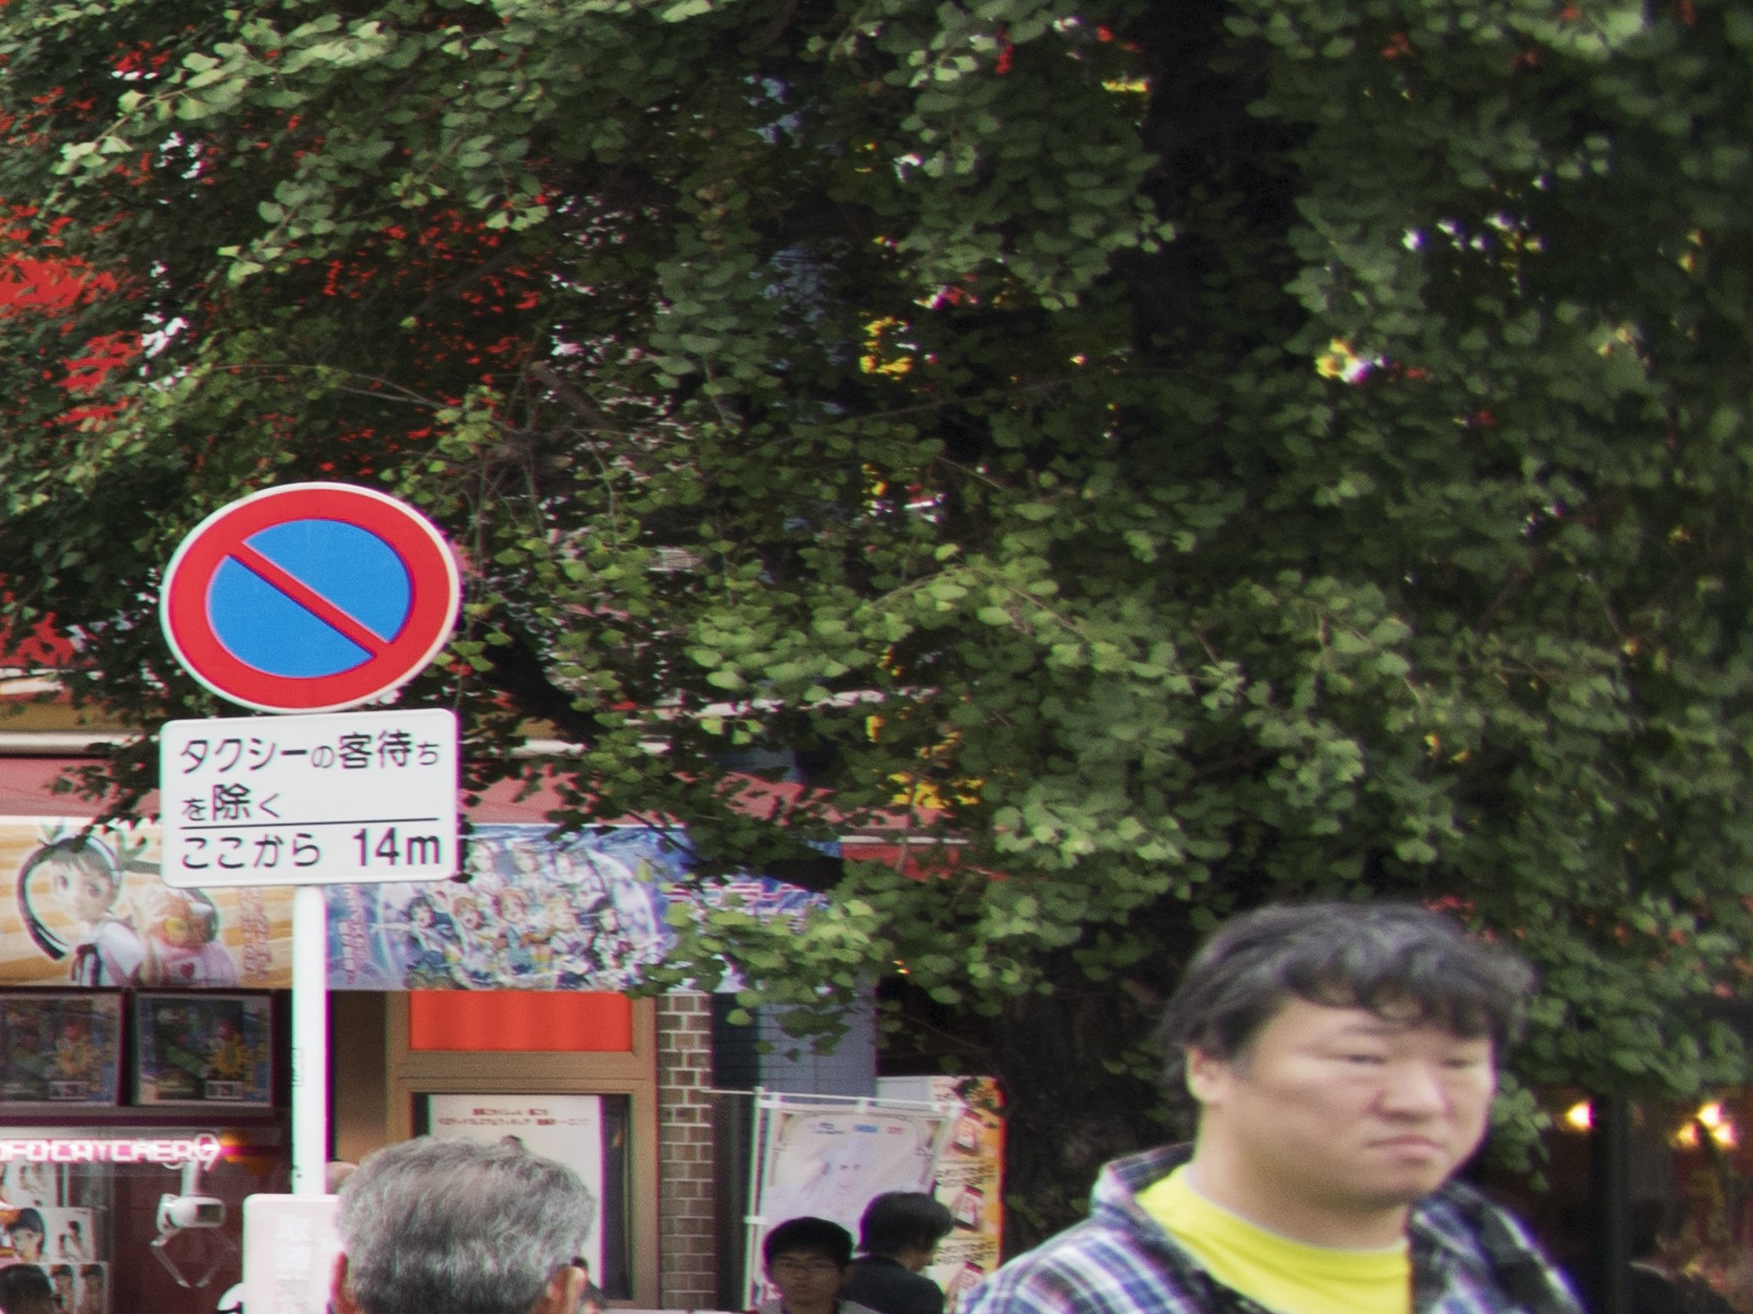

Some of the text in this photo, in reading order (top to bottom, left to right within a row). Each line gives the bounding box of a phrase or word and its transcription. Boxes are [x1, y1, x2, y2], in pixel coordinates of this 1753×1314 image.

[180, 729, 440, 774] タクシーの客待ち
[182, 783, 280, 822] を除く
[182, 827, 441, 869] ここから 14m
